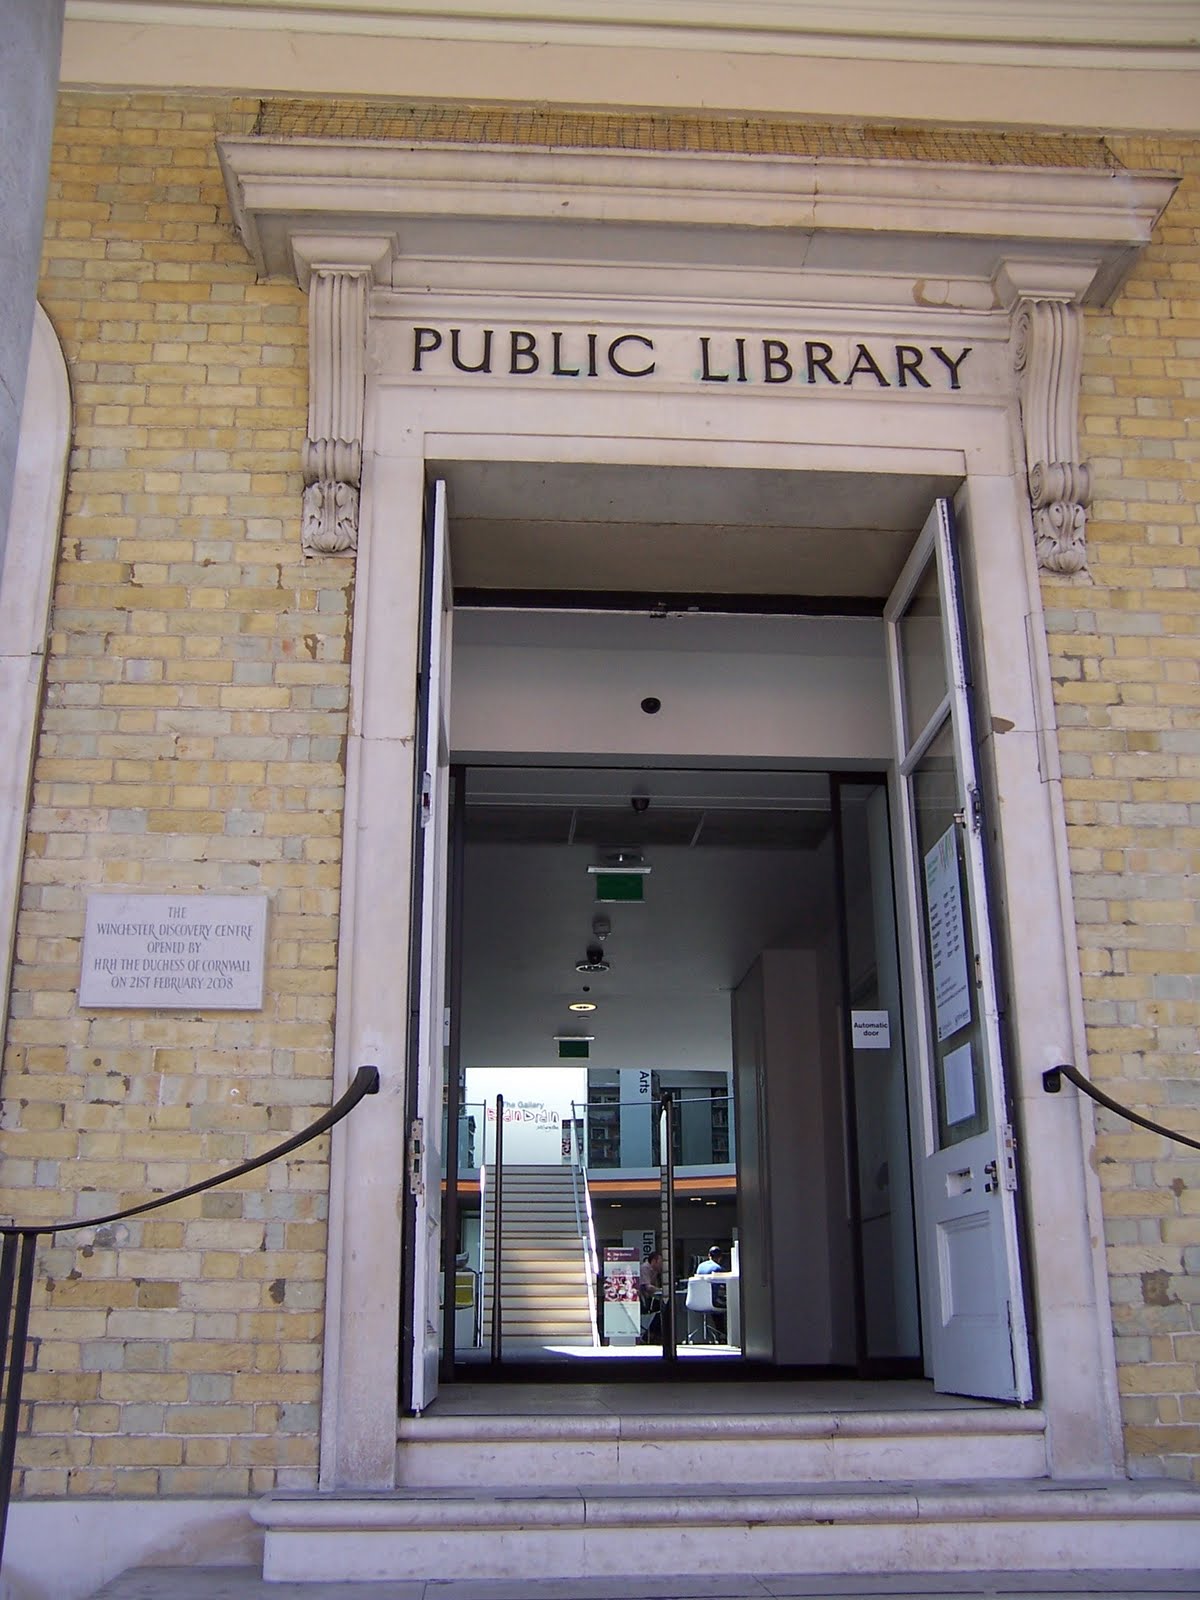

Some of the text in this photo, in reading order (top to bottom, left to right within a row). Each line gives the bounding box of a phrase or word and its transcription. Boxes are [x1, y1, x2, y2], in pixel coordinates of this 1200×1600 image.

[412, 326, 973, 389] PUBLIC LIBRARY
[168, 906, 187, 919] THE
[97, 923, 254, 940] WINCHESTER DISCOVERY CENTRE
[147, 941, 203, 954] OPENED BY
[94, 958, 251, 976] HRH THE DUCHESS OF CORNWALL
[111, 976, 234, 994] ON 21ST FEBRUARY 2008
[639, 1070, 650, 1094] Arts
[517, 1101, 544, 1109] Gallery
